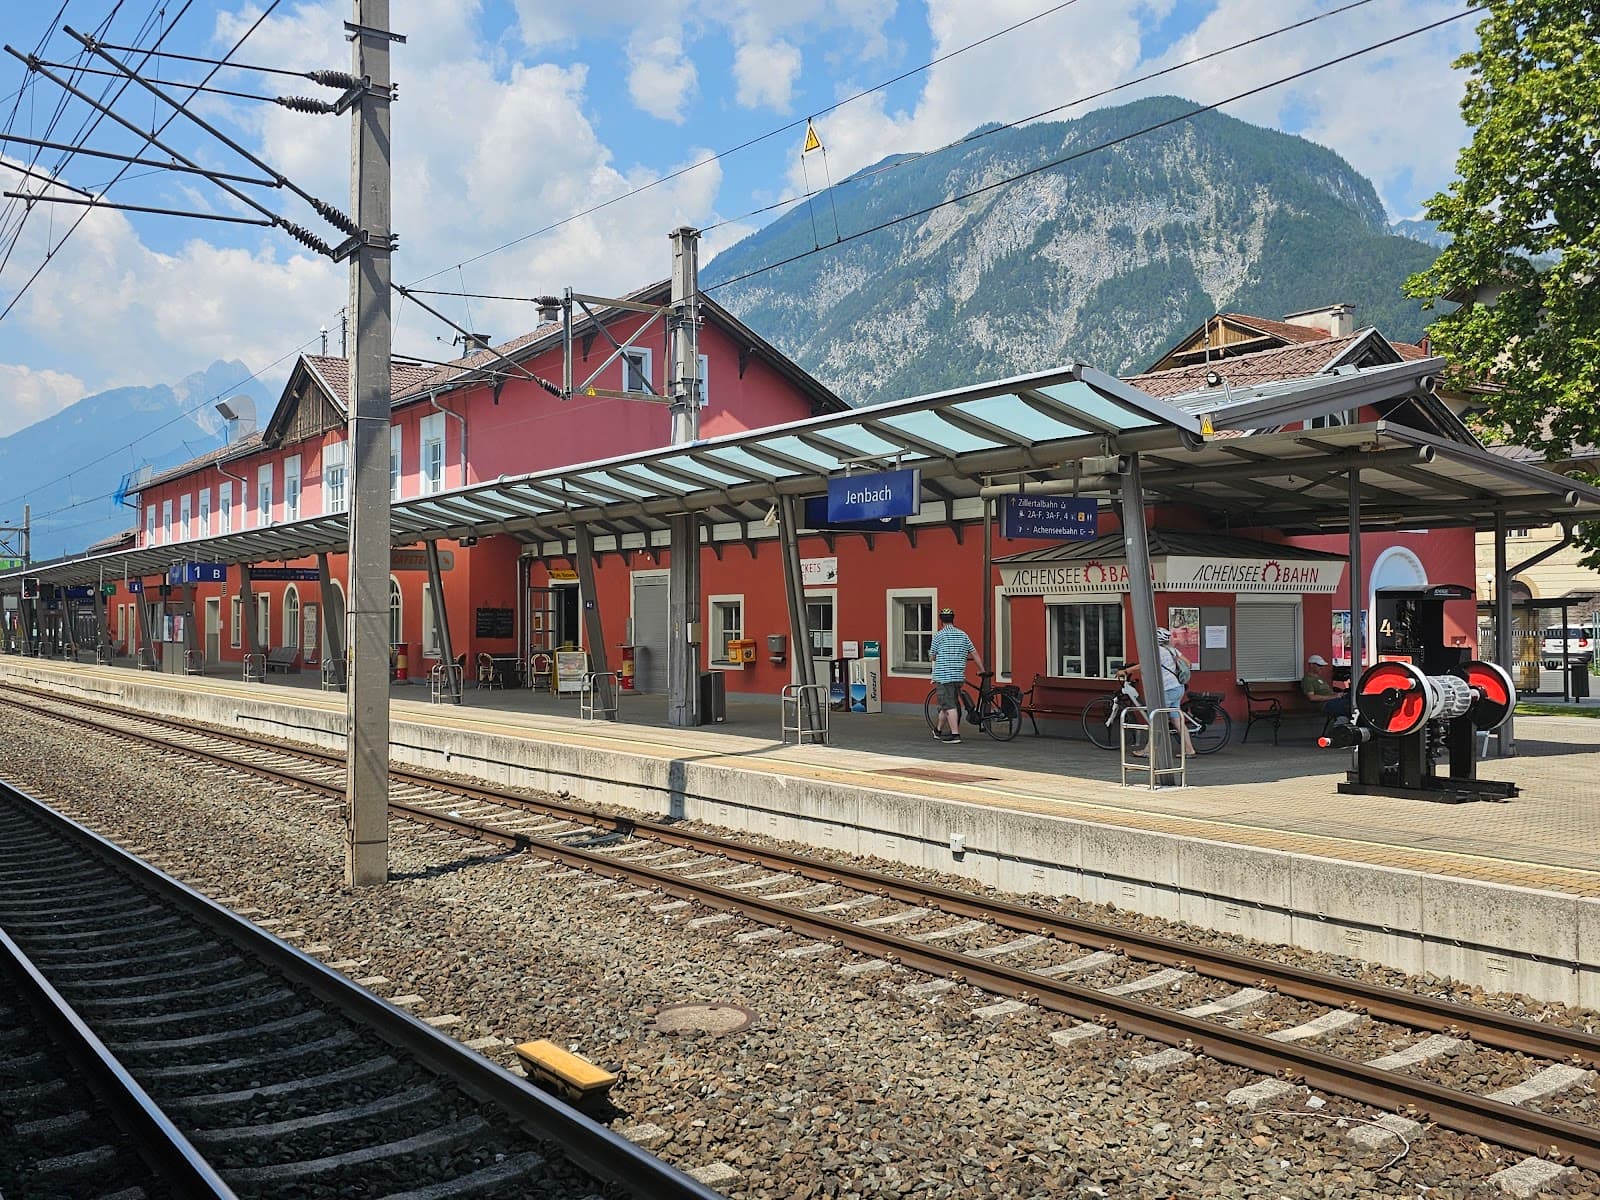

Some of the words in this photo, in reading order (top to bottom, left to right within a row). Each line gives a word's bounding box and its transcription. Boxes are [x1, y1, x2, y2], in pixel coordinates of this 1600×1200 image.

[845, 484, 892, 505] Jenbach
[1018, 498, 1058, 509] Zillertalbahn
[1063, 512, 1069, 520] 4
[1032, 526, 1078, 536] Achenseebahn
[194, 566, 200, 579] 1
[212, 569, 221, 579] B
[1012, 567, 1081, 586] ACHENSEE
[1109, 564, 1156, 583] BAN
[1193, 564, 1261, 582] ACHENSEE
[1282, 567, 1319, 583] BAHN
[1379, 618, 1394, 637] 4
